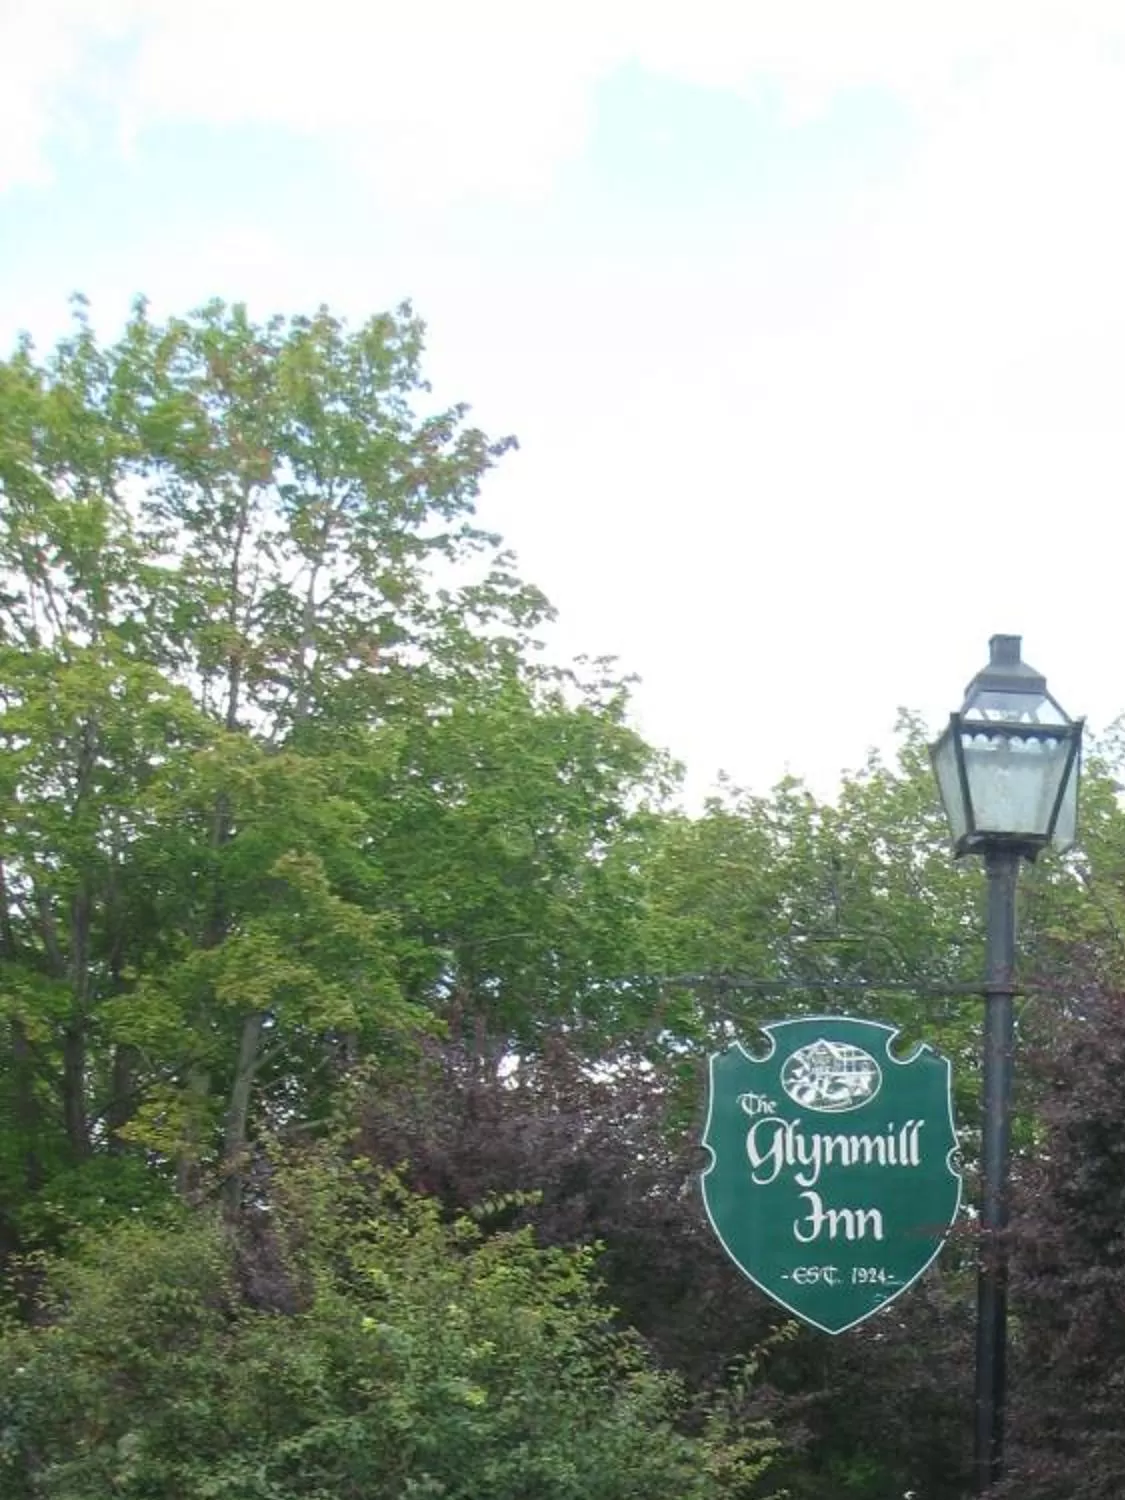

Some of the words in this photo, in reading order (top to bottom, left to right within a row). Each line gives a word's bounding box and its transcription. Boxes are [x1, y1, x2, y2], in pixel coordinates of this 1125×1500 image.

[736, 1093, 777, 1115] The
[747, 1117, 924, 1187] Glynmill
[793, 1191, 883, 1243] Inn
